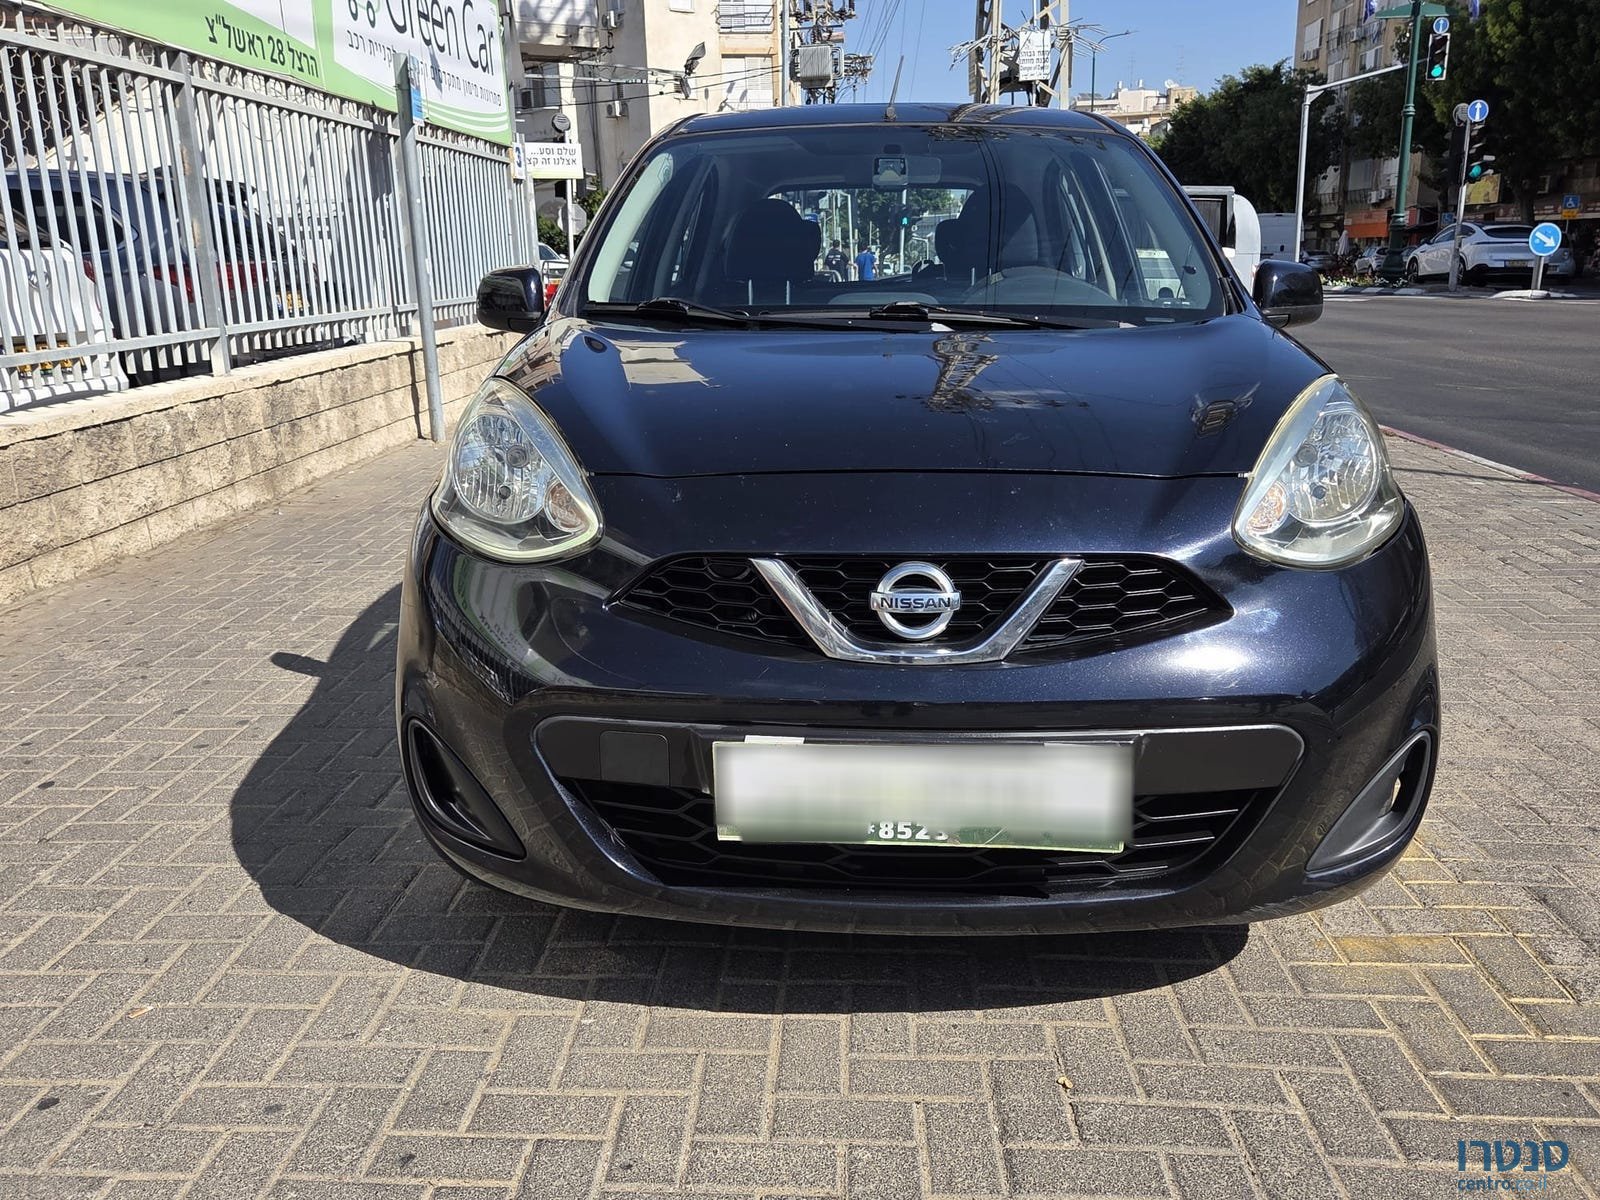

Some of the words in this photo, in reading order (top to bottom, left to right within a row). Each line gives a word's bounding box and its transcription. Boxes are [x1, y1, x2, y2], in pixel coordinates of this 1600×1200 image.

[462, 0, 494, 76] Car
[267, 35, 286, 66] 28
[287, 40, 319, 78] הרצל
[557, 147, 577, 156] שלם
[526, 157, 539, 167] קצ
[541, 157, 551, 165] זה
[553, 157, 577, 166] אצלנו
[880, 597, 951, 609] NISSAN
